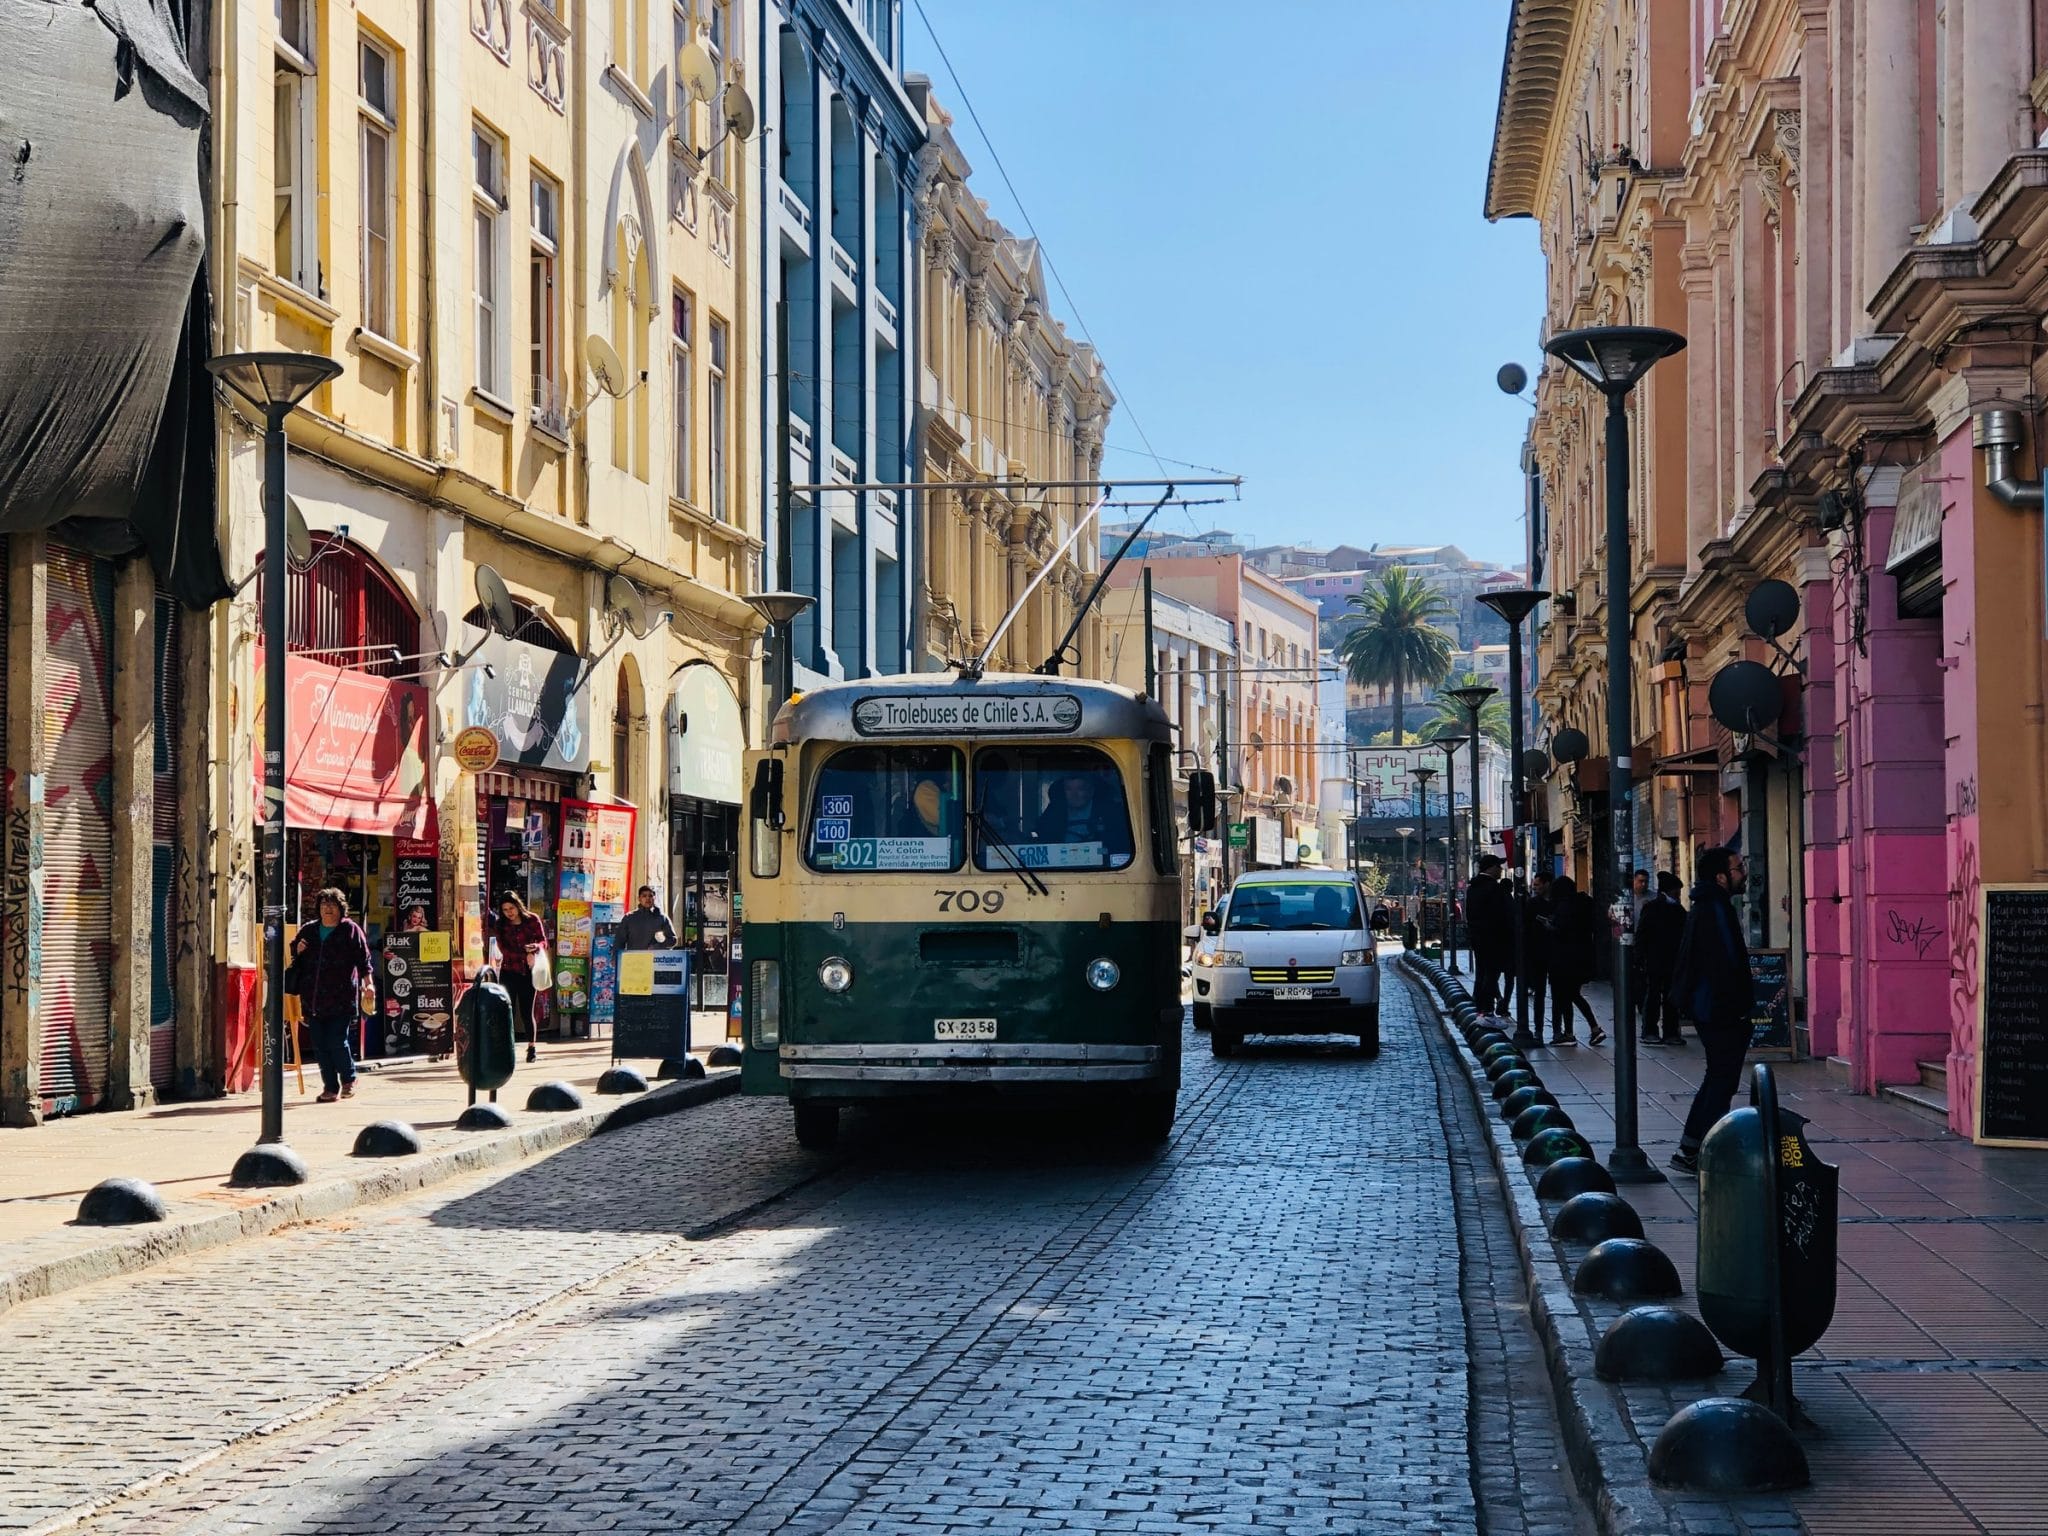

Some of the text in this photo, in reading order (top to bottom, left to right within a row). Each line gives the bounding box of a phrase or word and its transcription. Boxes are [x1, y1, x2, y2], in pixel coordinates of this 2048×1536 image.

[885, 701, 1049, 724] Trolebuses de Chile S.A.
[879, 839, 925, 847] Aduana
[838, 842, 874, 866] 802
[879, 860, 949, 869] Avenida Argentina
[933, 889, 1005, 914] 709
[937, 1020, 954, 1034] CX
